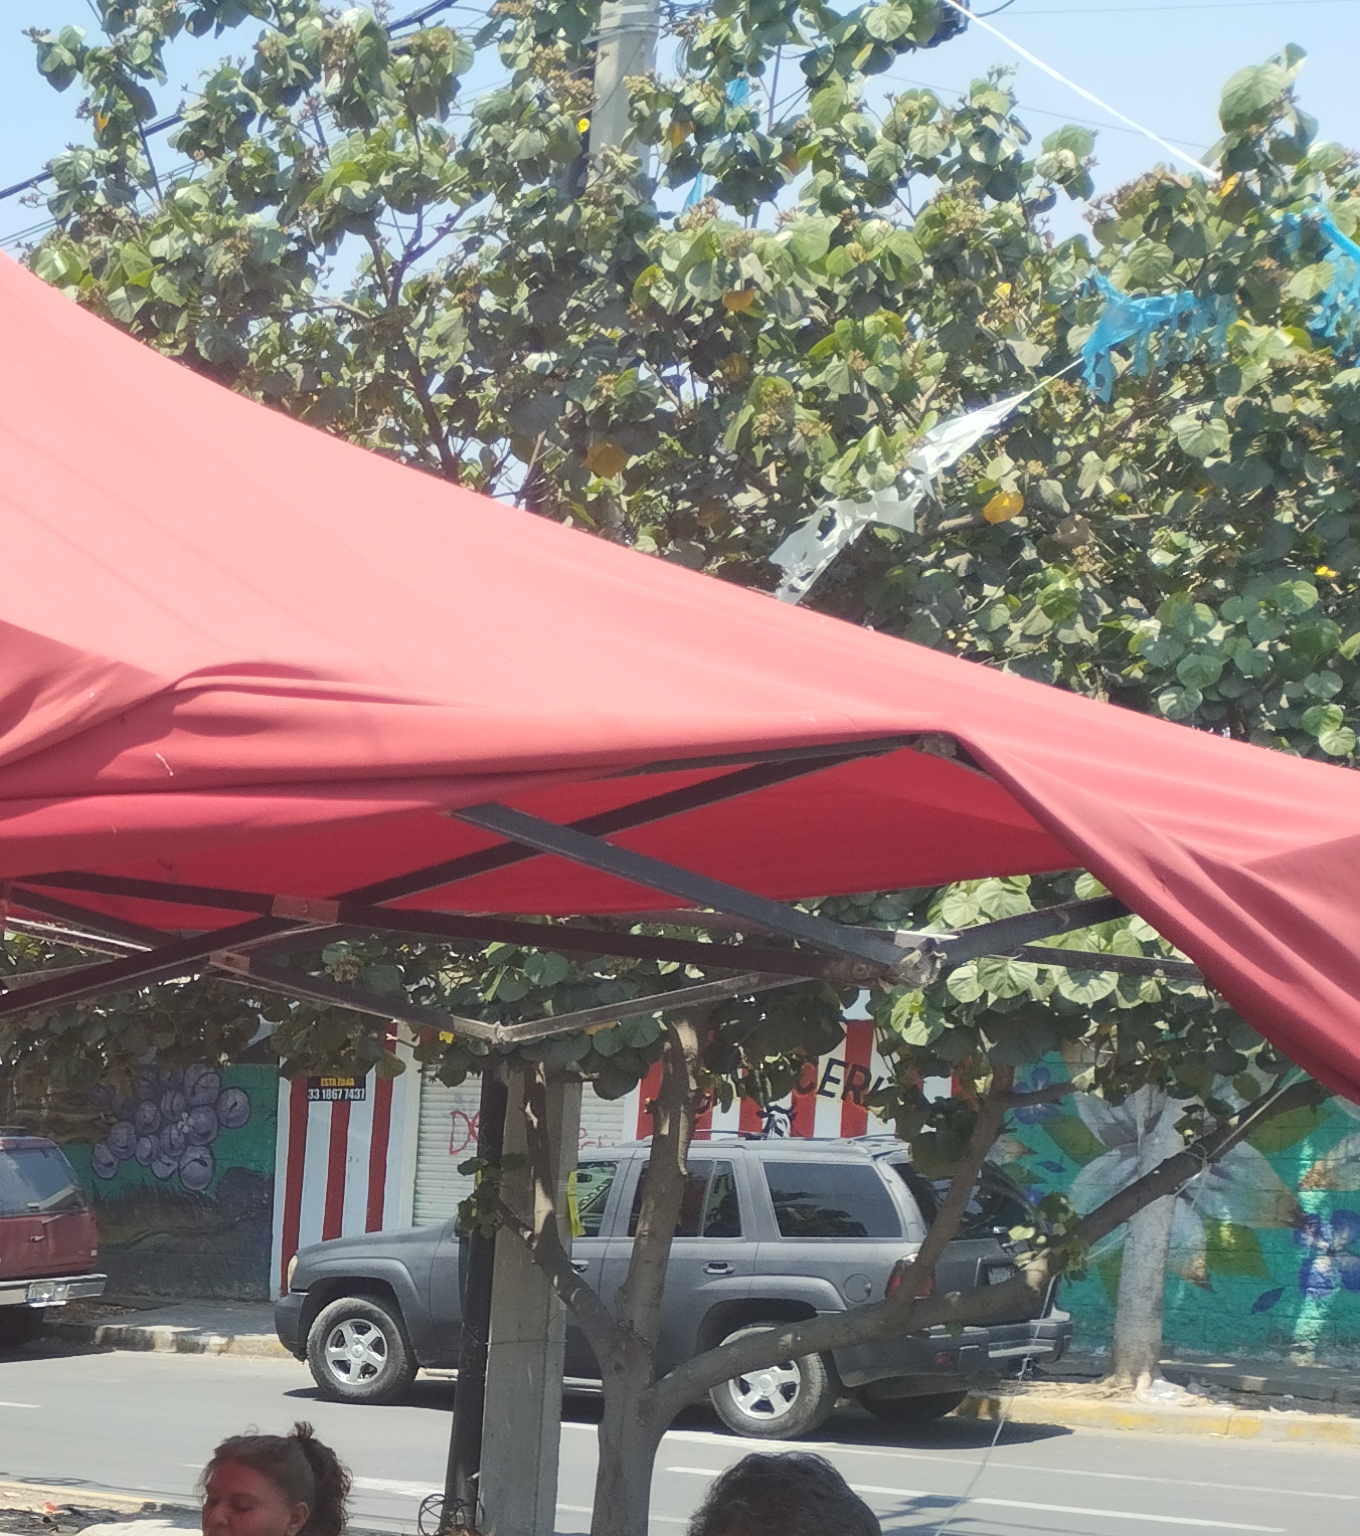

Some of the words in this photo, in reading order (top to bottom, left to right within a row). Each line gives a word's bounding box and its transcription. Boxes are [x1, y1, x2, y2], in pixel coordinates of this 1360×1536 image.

[320, 1077, 337, 1087] ESTA
[338, 1077, 355, 1087] ZONA
[308, 1088, 320, 1100] 33
[322, 1088, 343, 1100] 1867
[344, 1088, 365, 1100] 7437
